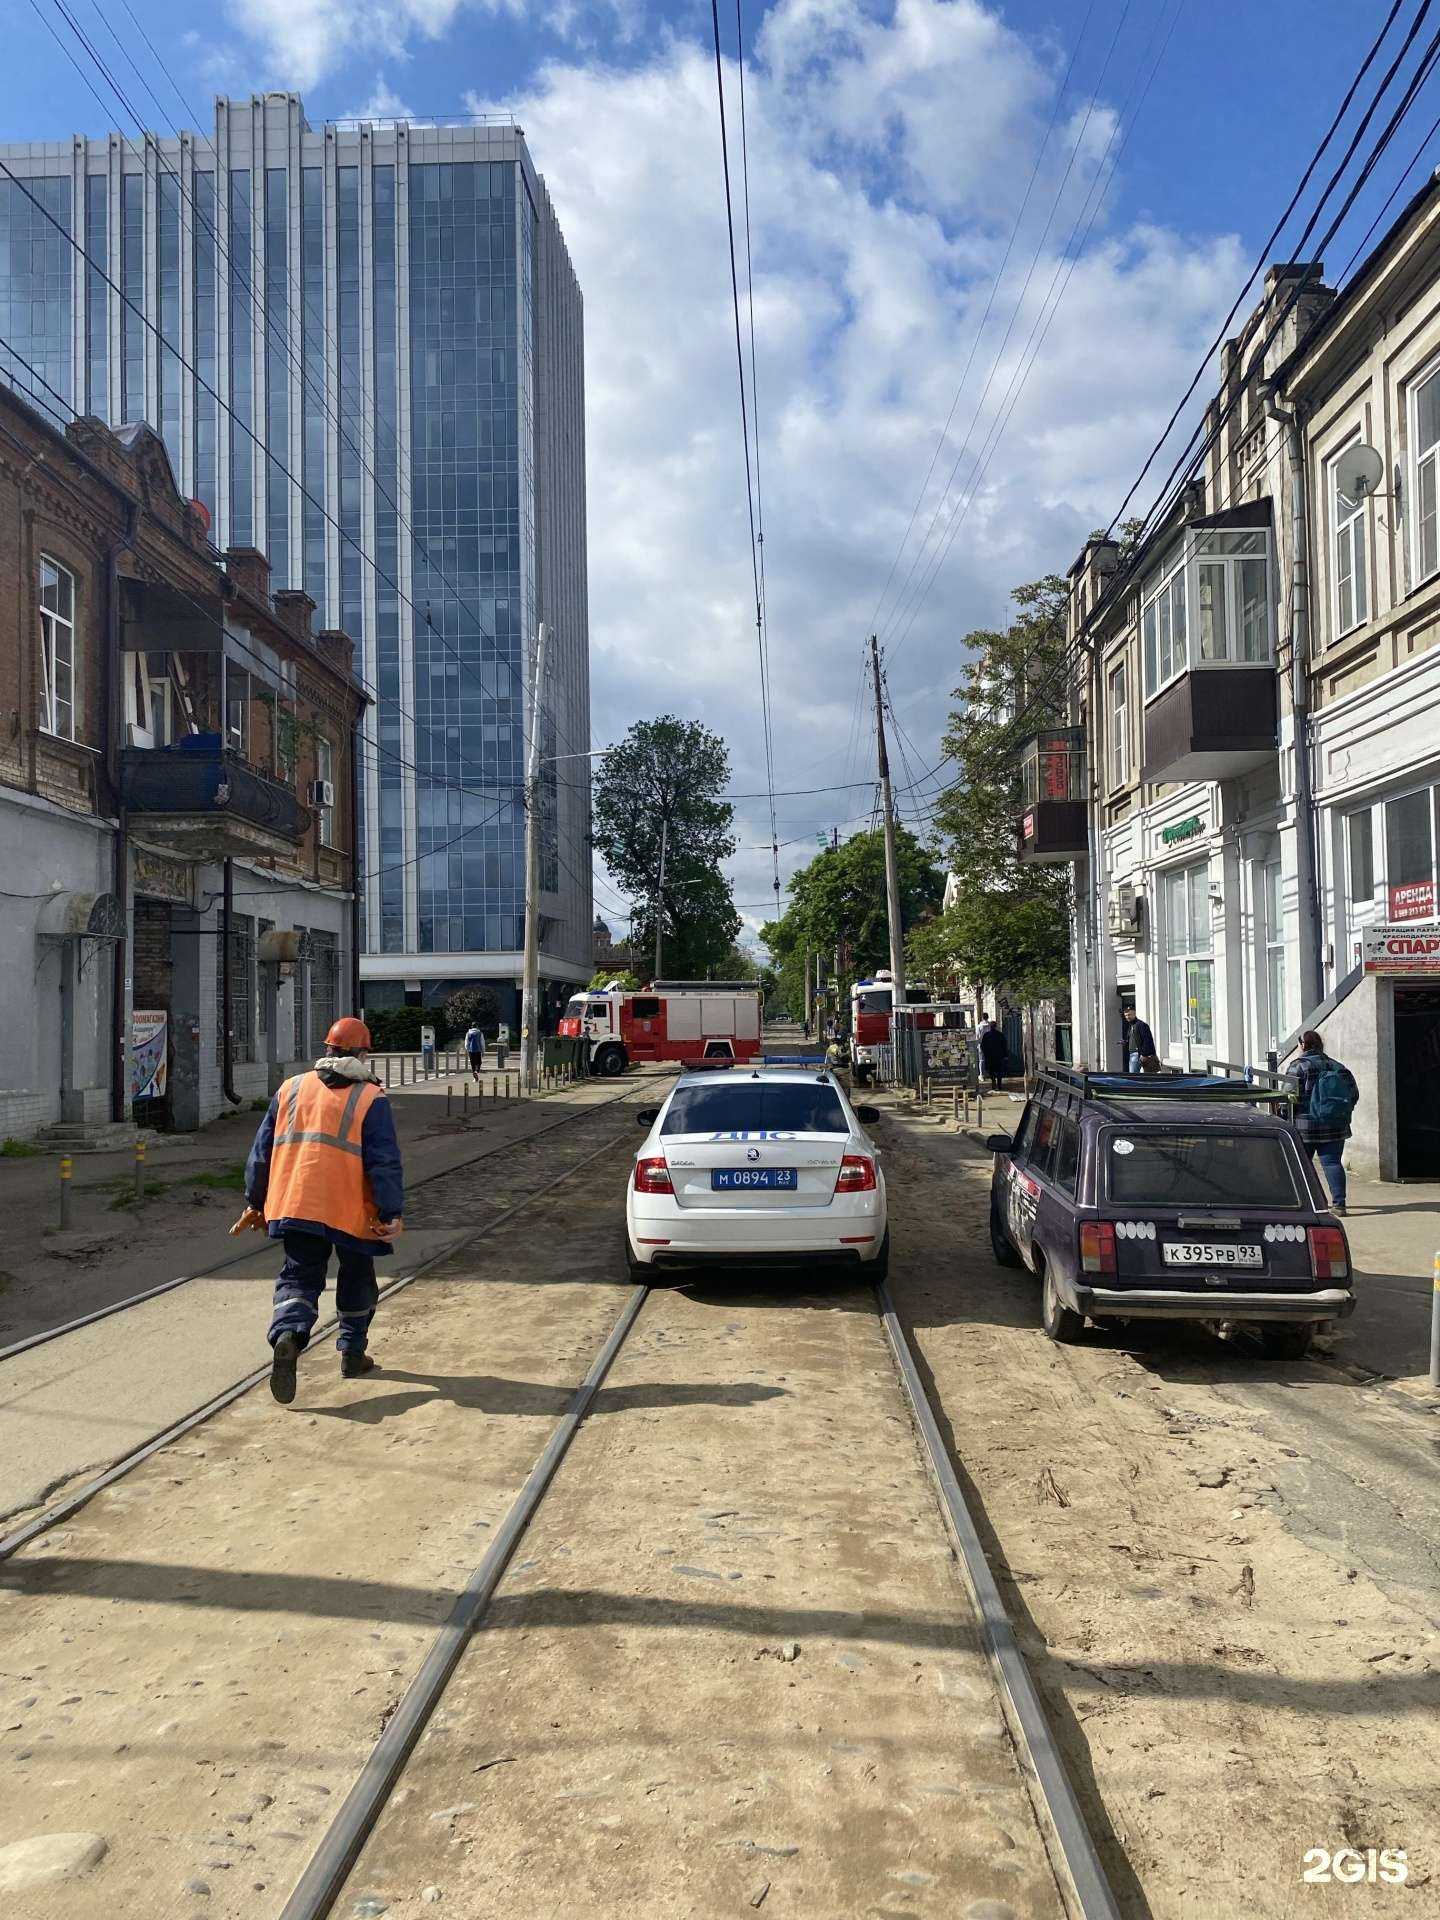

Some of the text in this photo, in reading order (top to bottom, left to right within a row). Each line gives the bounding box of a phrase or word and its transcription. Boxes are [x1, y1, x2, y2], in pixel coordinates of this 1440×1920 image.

[1395, 886, 1432, 905] АРЕНДА
[1387, 939, 1440, 954] СПАР
[709, 1131, 797, 1142] ДПС
[1239, 1246, 1256, 1258] 93
